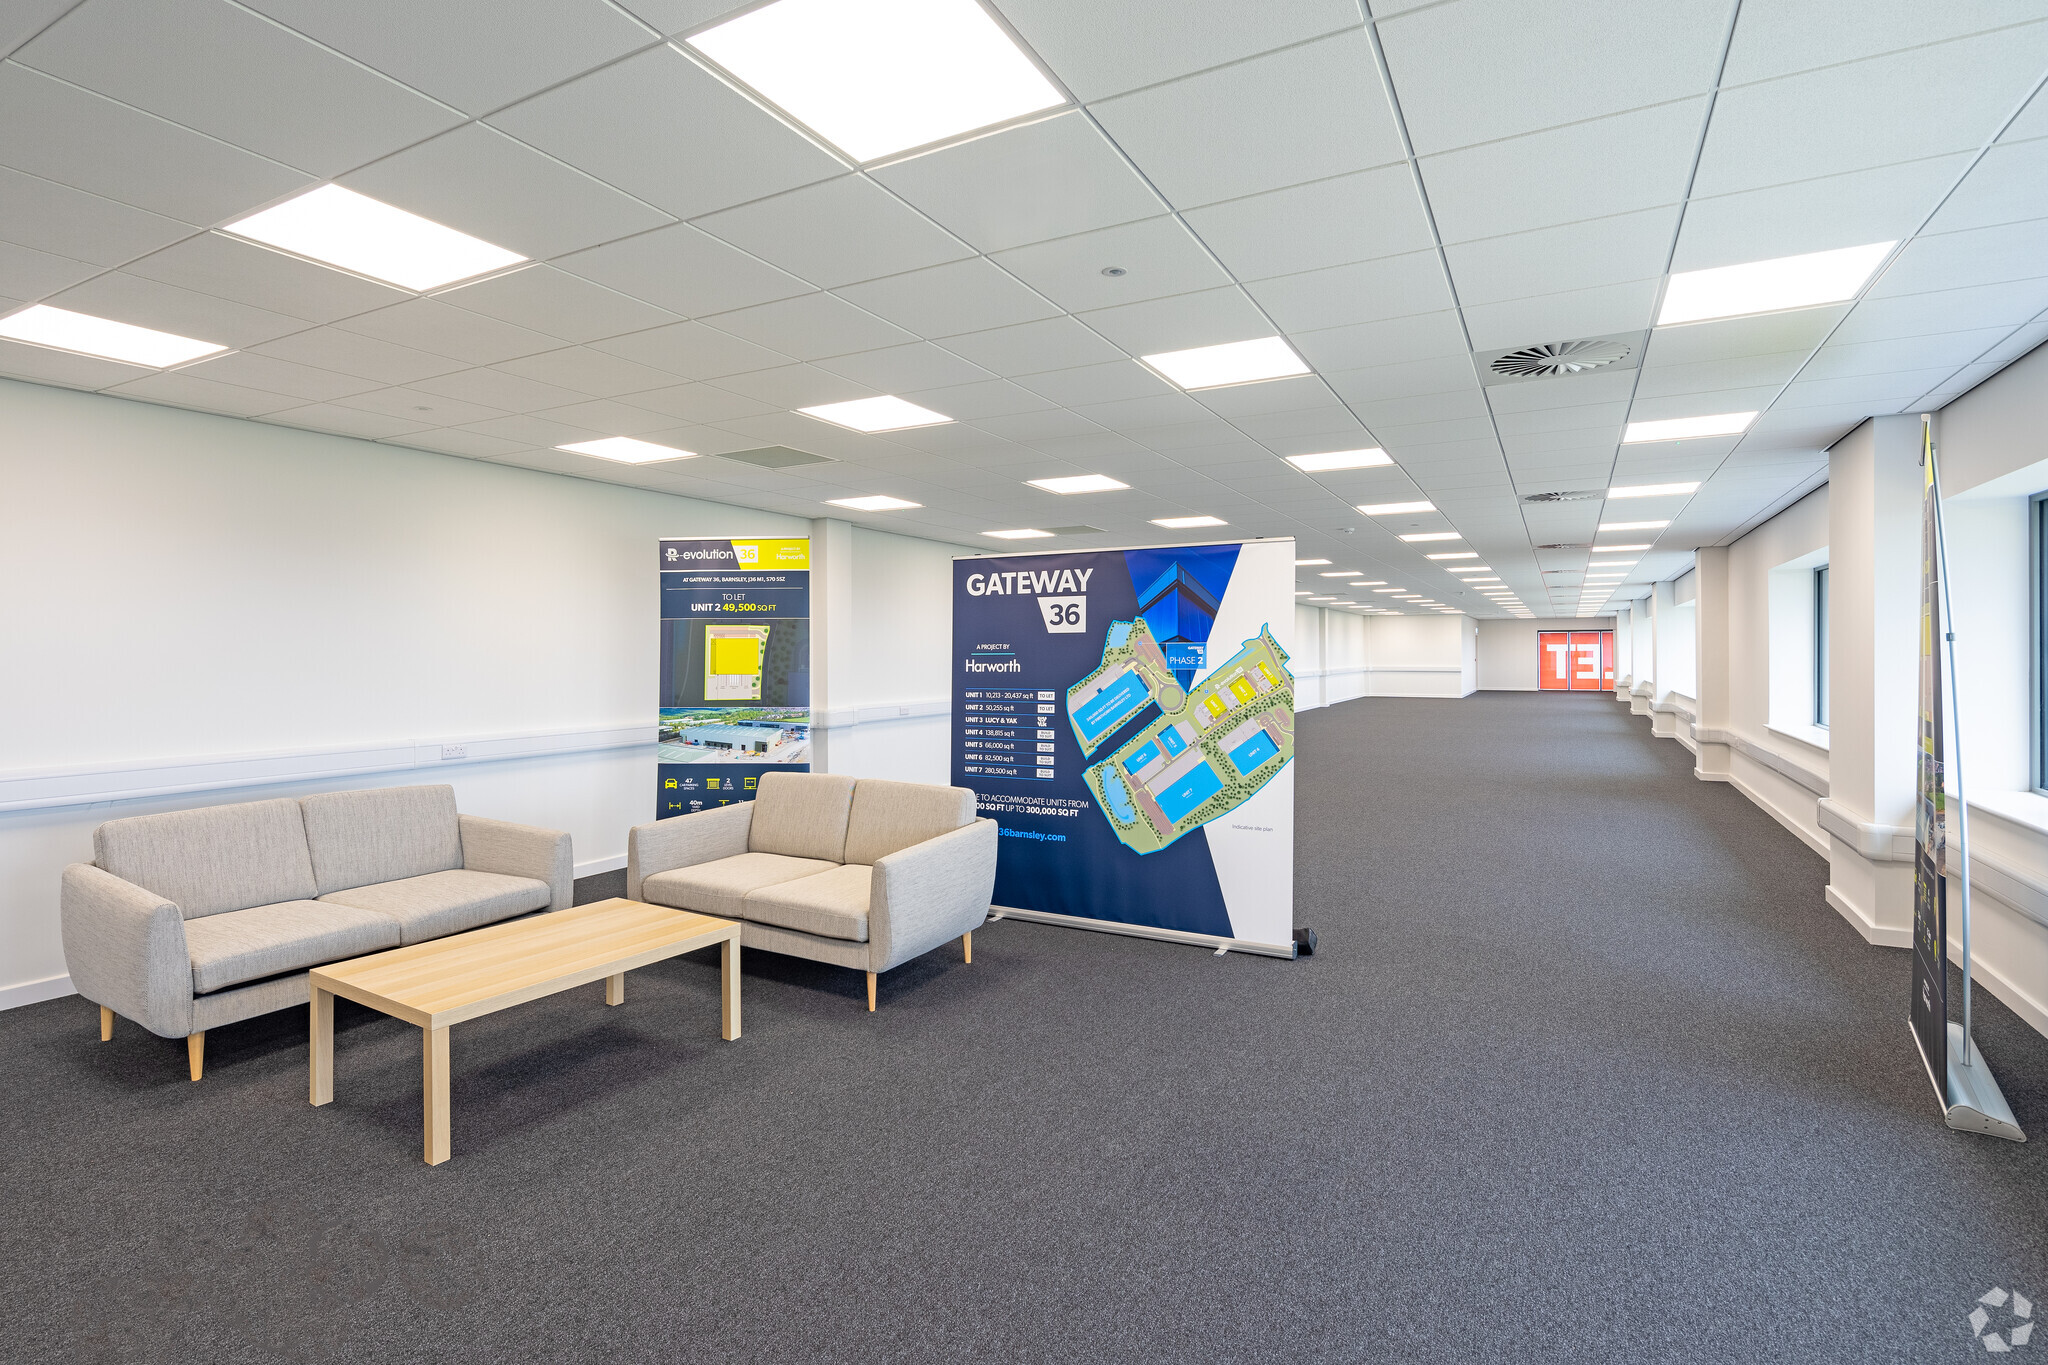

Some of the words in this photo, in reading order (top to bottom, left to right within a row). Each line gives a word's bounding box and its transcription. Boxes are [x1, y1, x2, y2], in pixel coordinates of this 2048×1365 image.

[740, 549, 755, 559] 36
[966, 568, 1093, 596] GATEWAY
[722, 604, 756, 612] 49,500
[1049, 604, 1080, 626] 36
[966, 659, 1020, 672] Harworth
[991, 795, 1045, 805] ACCOMMODATE
[1046, 799, 1067, 807] UNITS
[1068, 800, 1089, 808] FROM
[1026, 806, 1056, 815] 300,000
[998, 828, 1066, 842] 36barnsley.com
